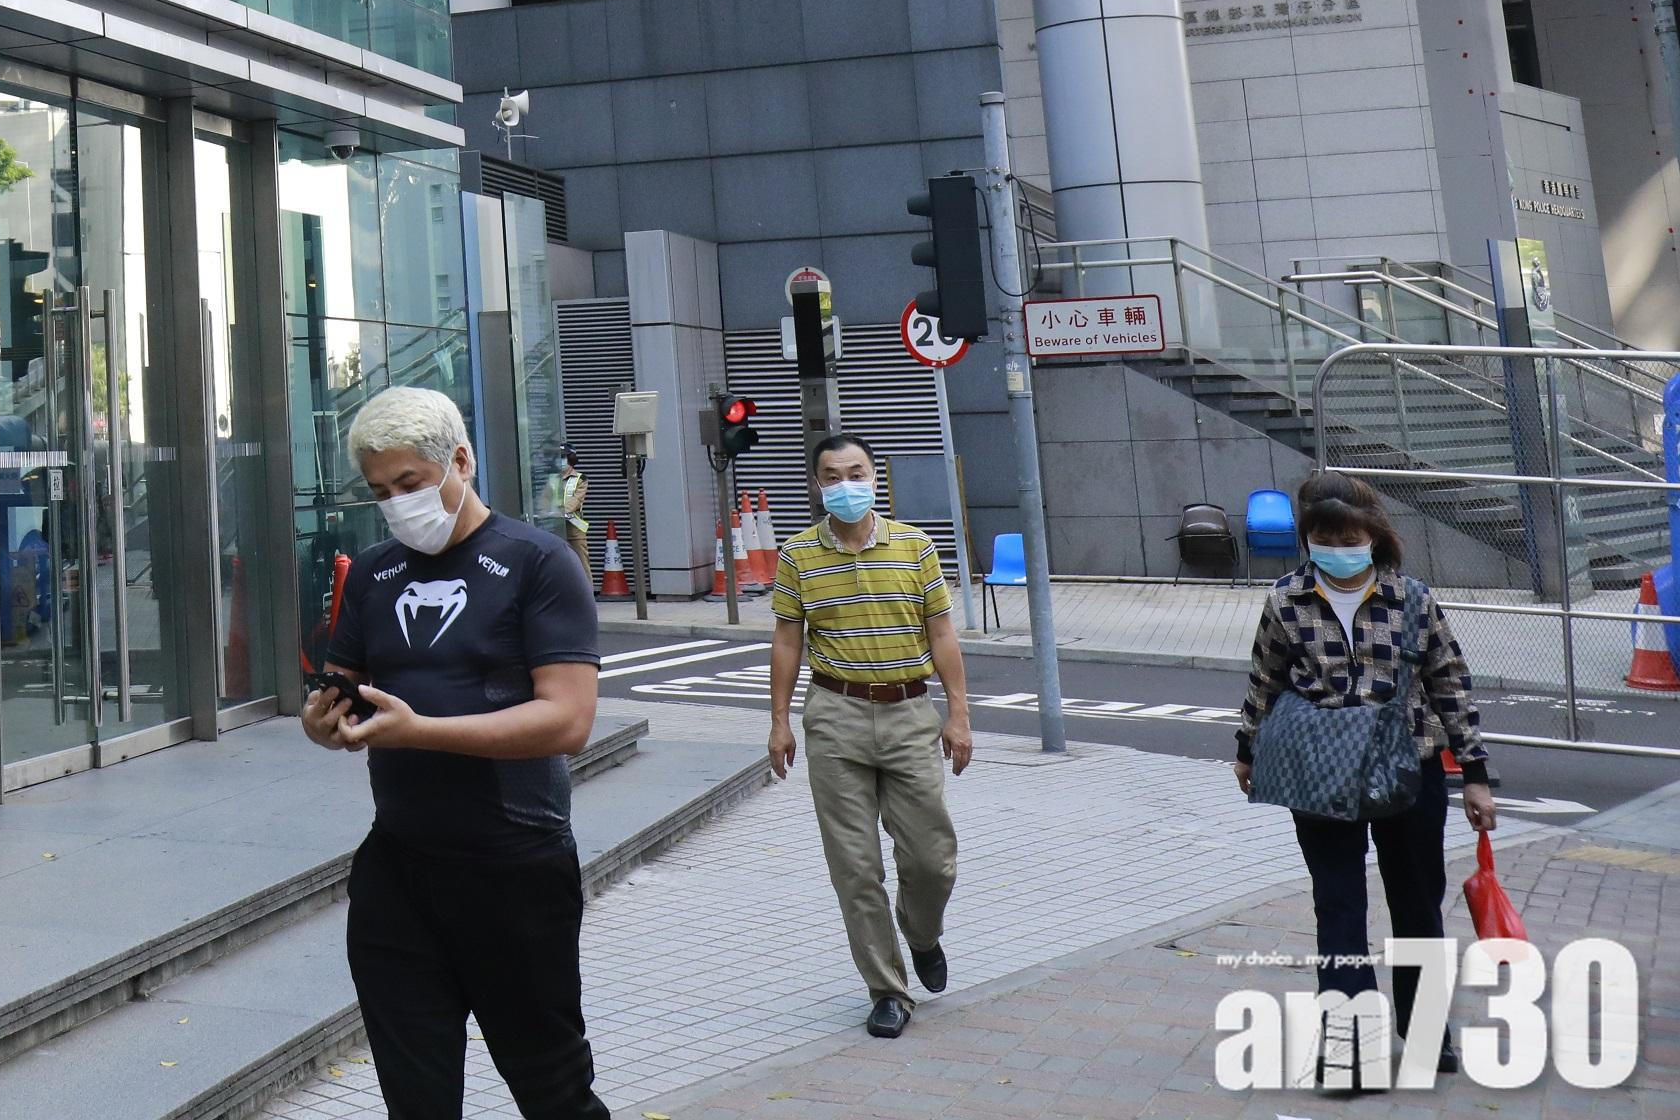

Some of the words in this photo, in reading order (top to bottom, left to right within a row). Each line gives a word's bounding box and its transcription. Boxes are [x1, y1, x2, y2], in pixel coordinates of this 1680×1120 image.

[1040, 306, 1147, 330] 小心車輛
[1034, 334, 1081, 347] Beware
[1086, 333, 1099, 345] of
[1103, 332, 1158, 345] Vehicles
[373, 560, 408, 582] VENUM
[477, 553, 511, 578] VENUM
